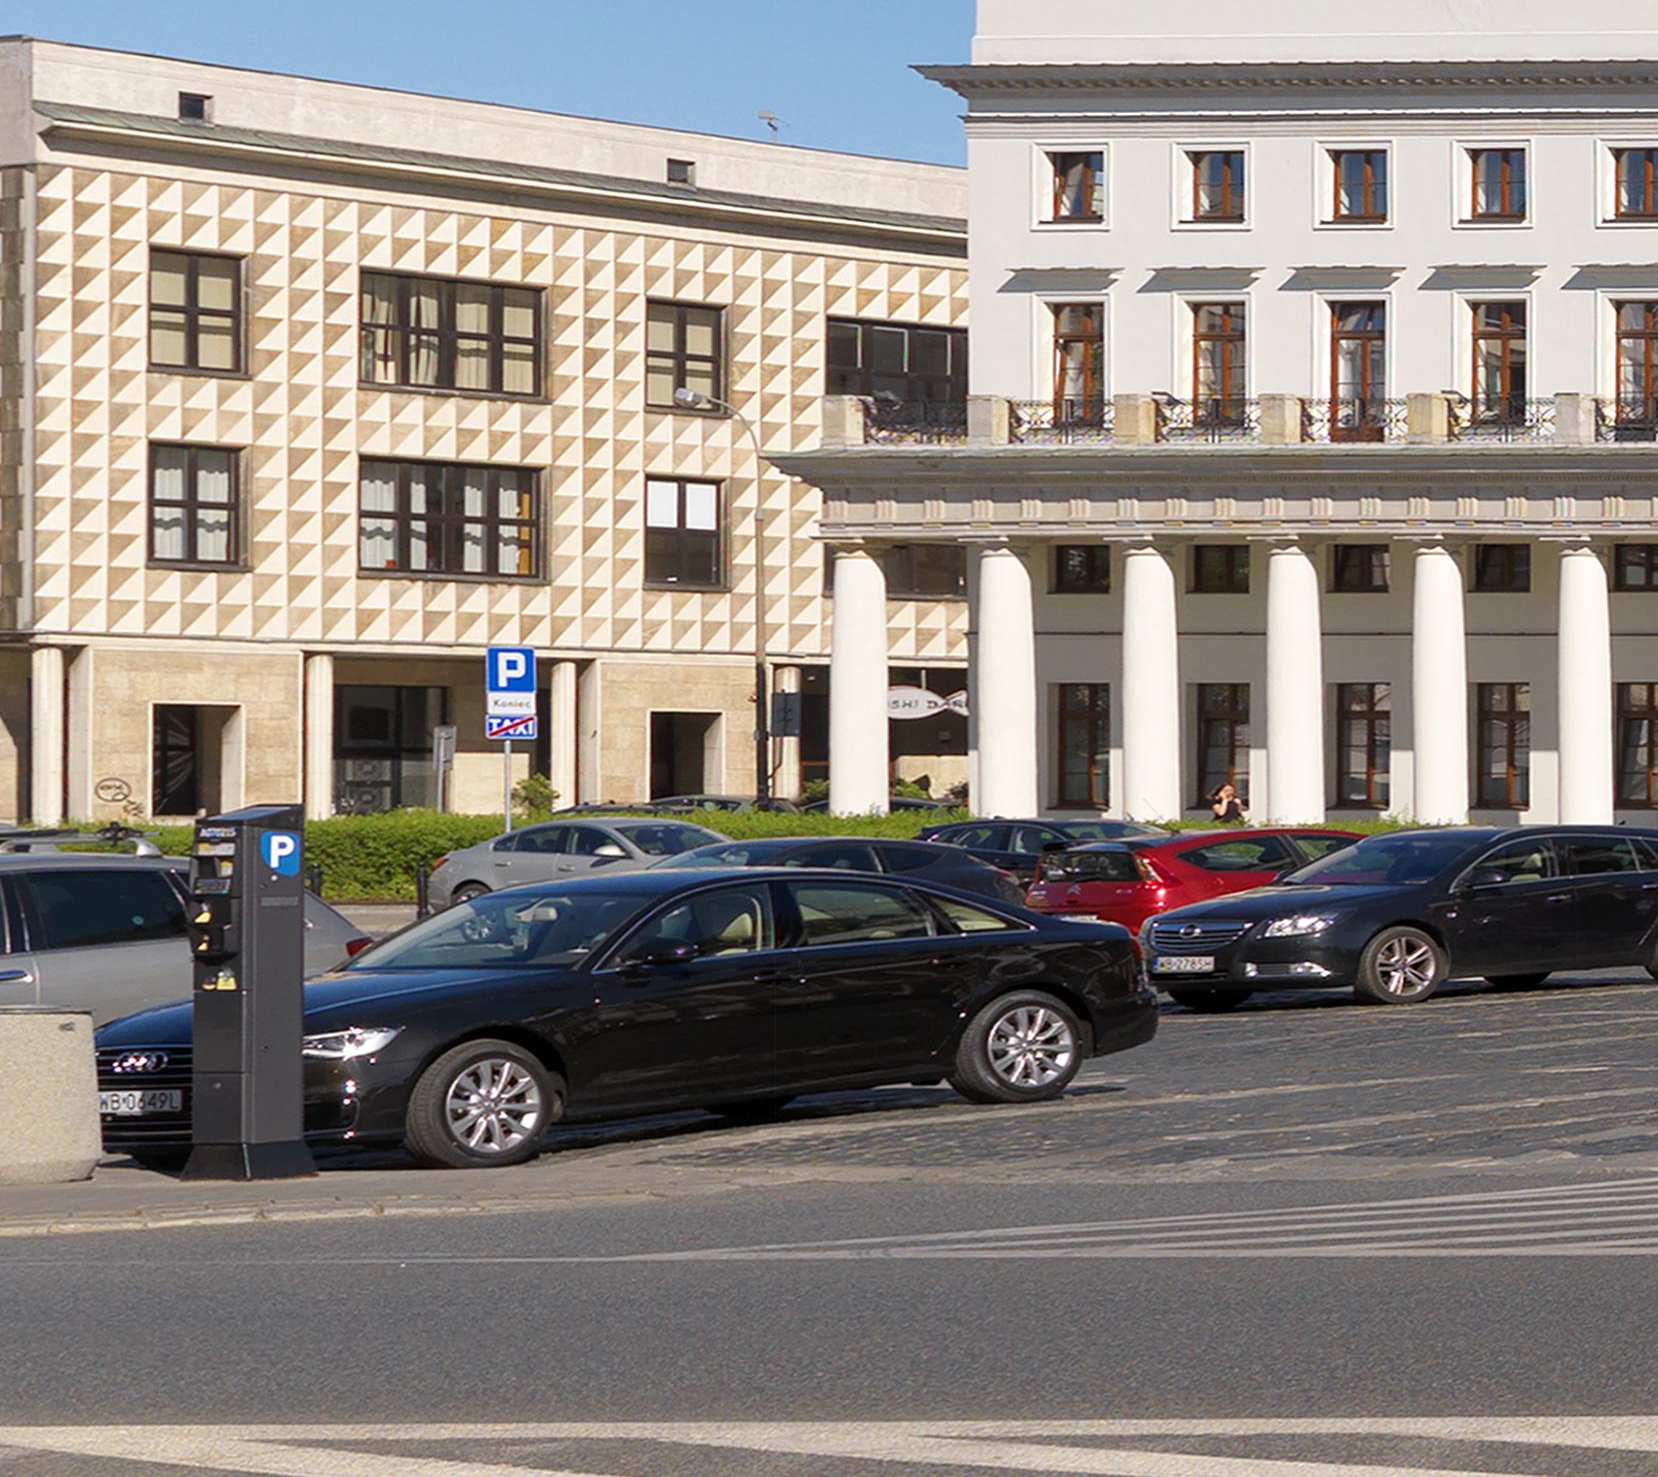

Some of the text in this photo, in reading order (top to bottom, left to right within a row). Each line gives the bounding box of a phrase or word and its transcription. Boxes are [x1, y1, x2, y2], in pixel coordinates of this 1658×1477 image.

[497, 652, 526, 688] P
[494, 699, 531, 708] Koniec
[489, 718, 535, 735] TAXI
[270, 835, 295, 869] P
[126, 1091, 178, 1111] 0649L
